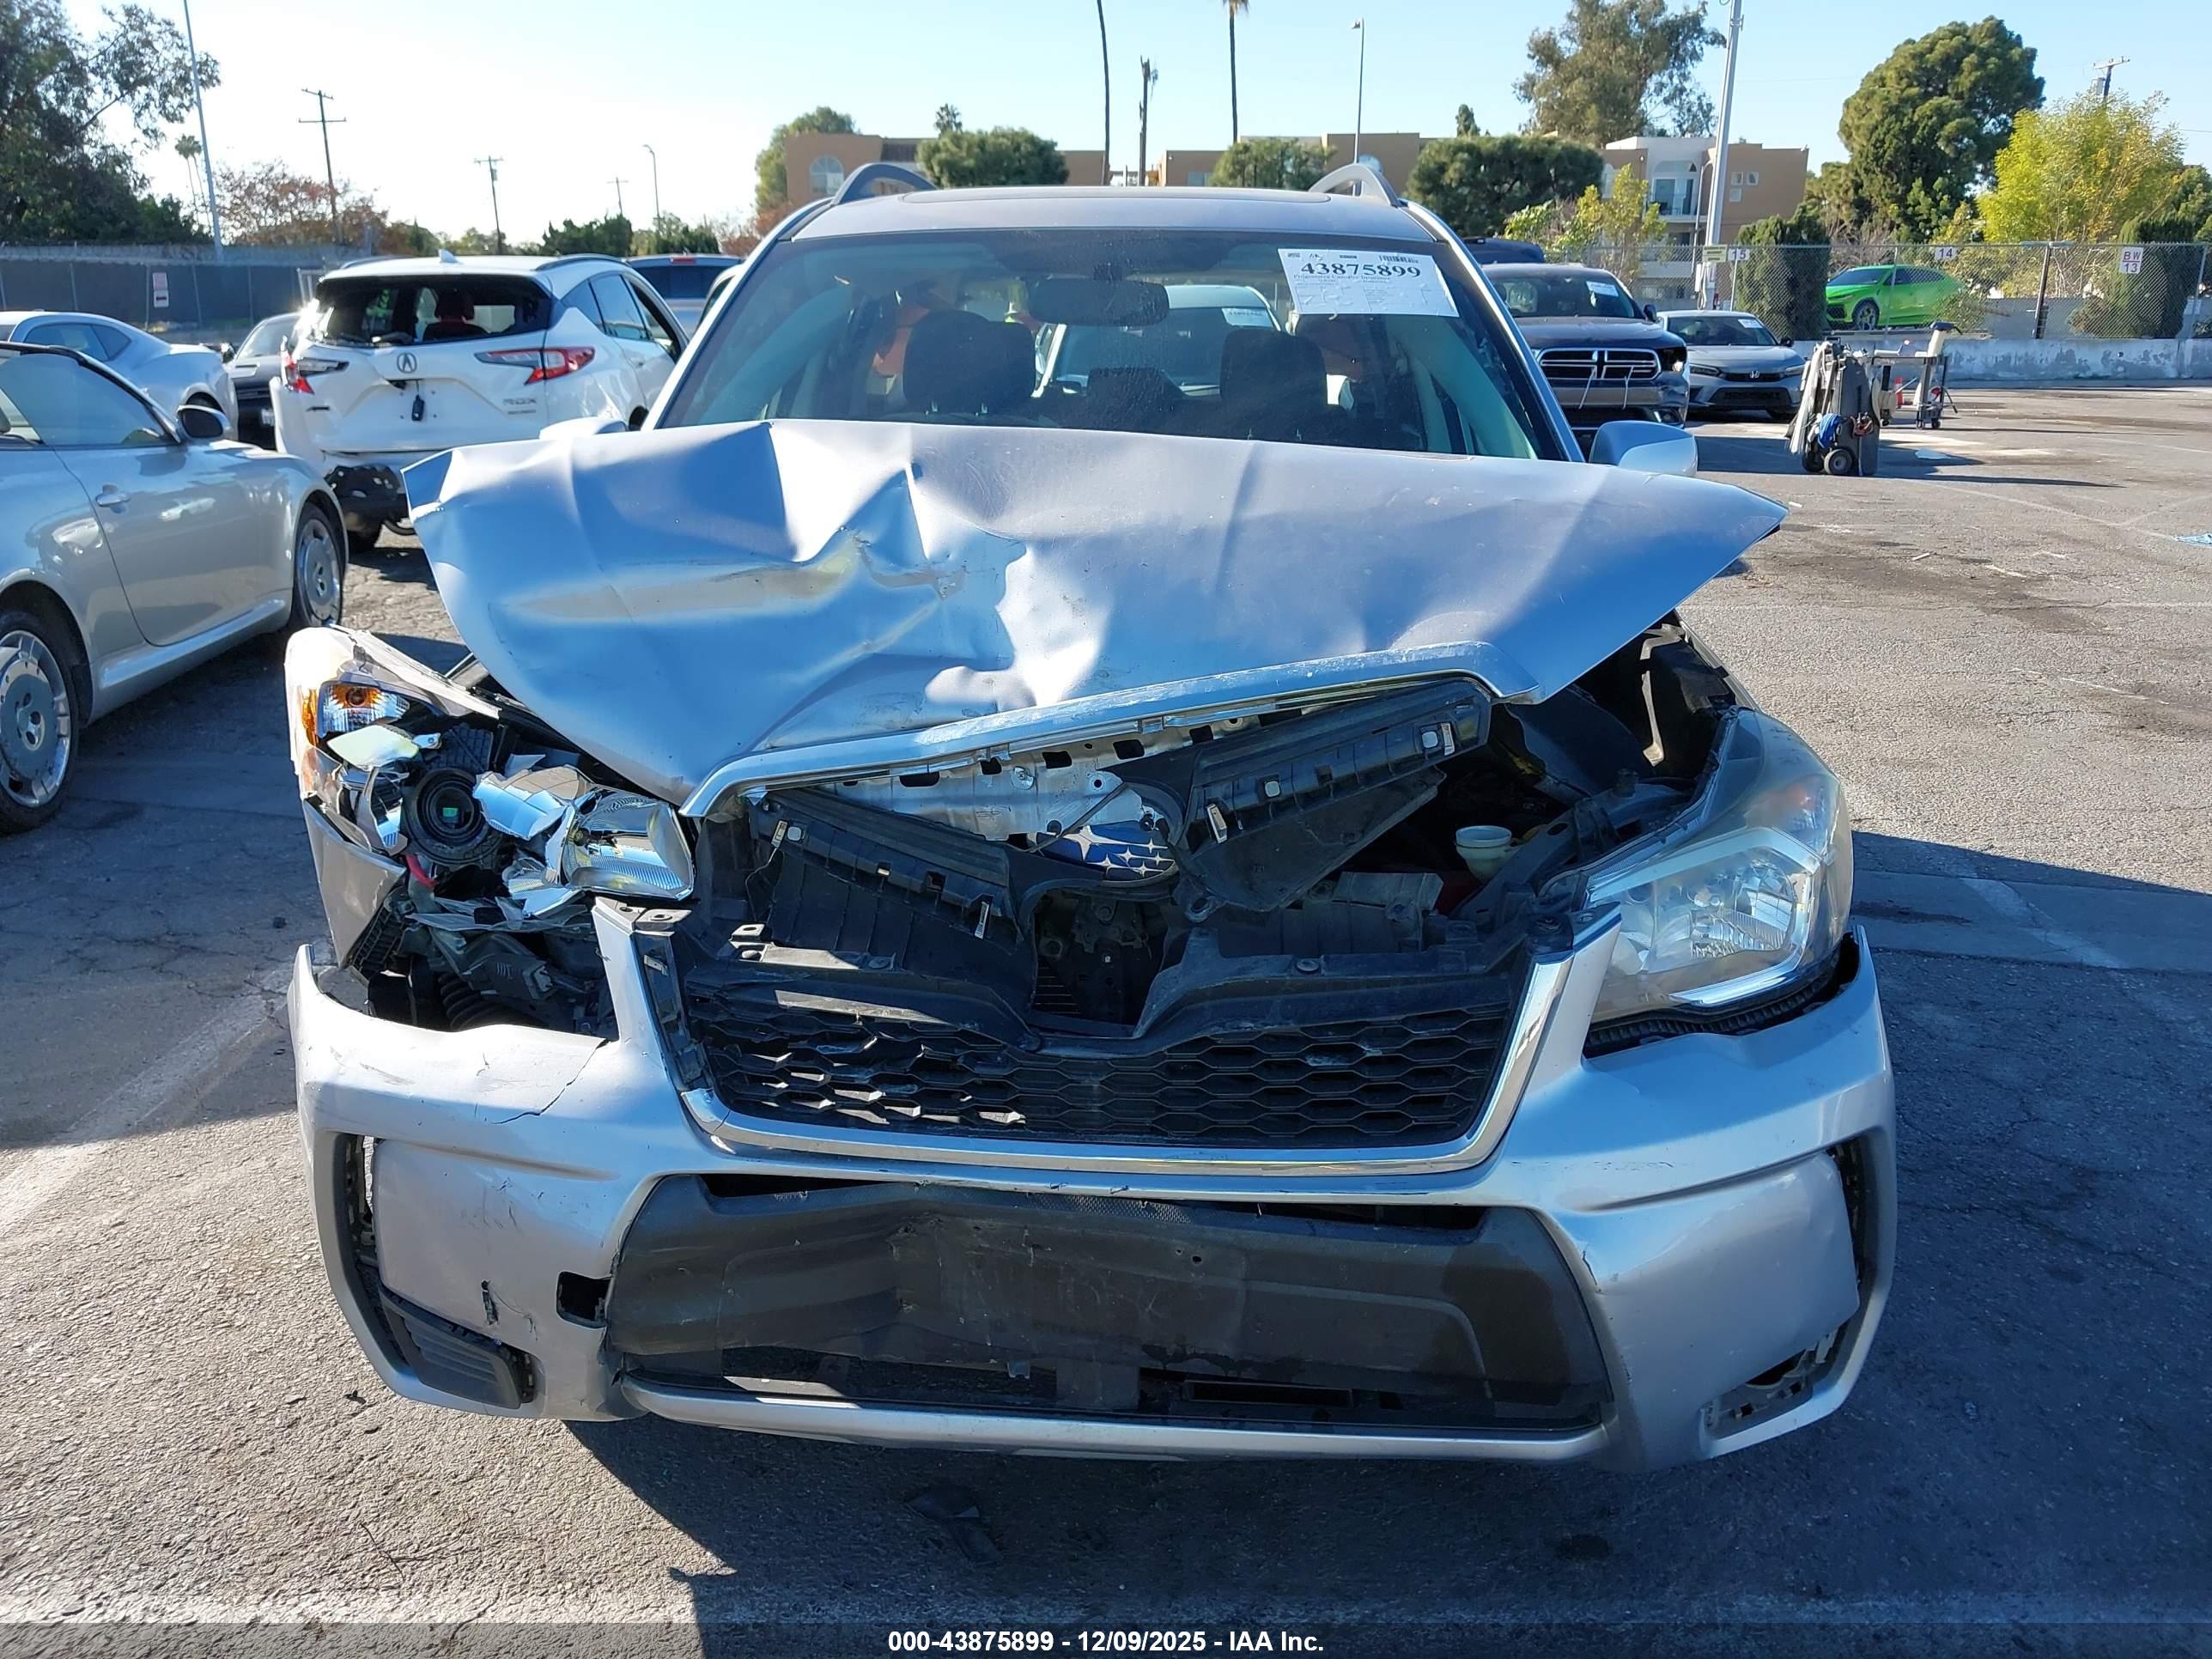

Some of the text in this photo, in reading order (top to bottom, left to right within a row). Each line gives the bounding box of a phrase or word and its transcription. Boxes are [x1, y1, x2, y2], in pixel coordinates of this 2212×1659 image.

[1731, 249, 1747, 259] 15
[1939, 247, 1953, 258] 14
[2124, 251, 2142, 260] BW
[1301, 262, 1421, 278] 43875899
[2124, 263, 2137, 273] 13
